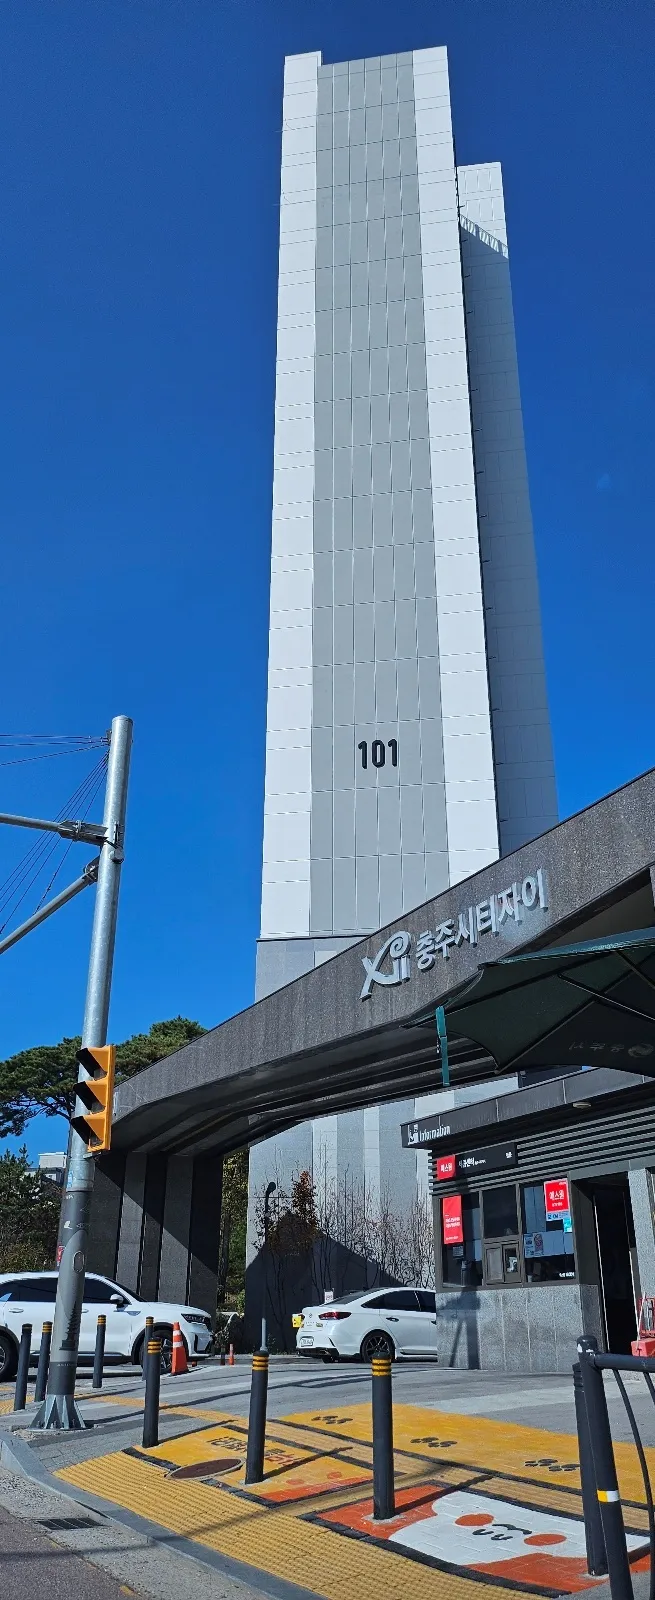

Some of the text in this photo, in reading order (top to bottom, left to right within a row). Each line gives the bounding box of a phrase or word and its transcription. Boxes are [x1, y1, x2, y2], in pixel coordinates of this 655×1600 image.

[358, 738, 398, 770] 101
[416, 867, 549, 973] 충주시티자이
[549, 1189, 565, 1200] 에스원
